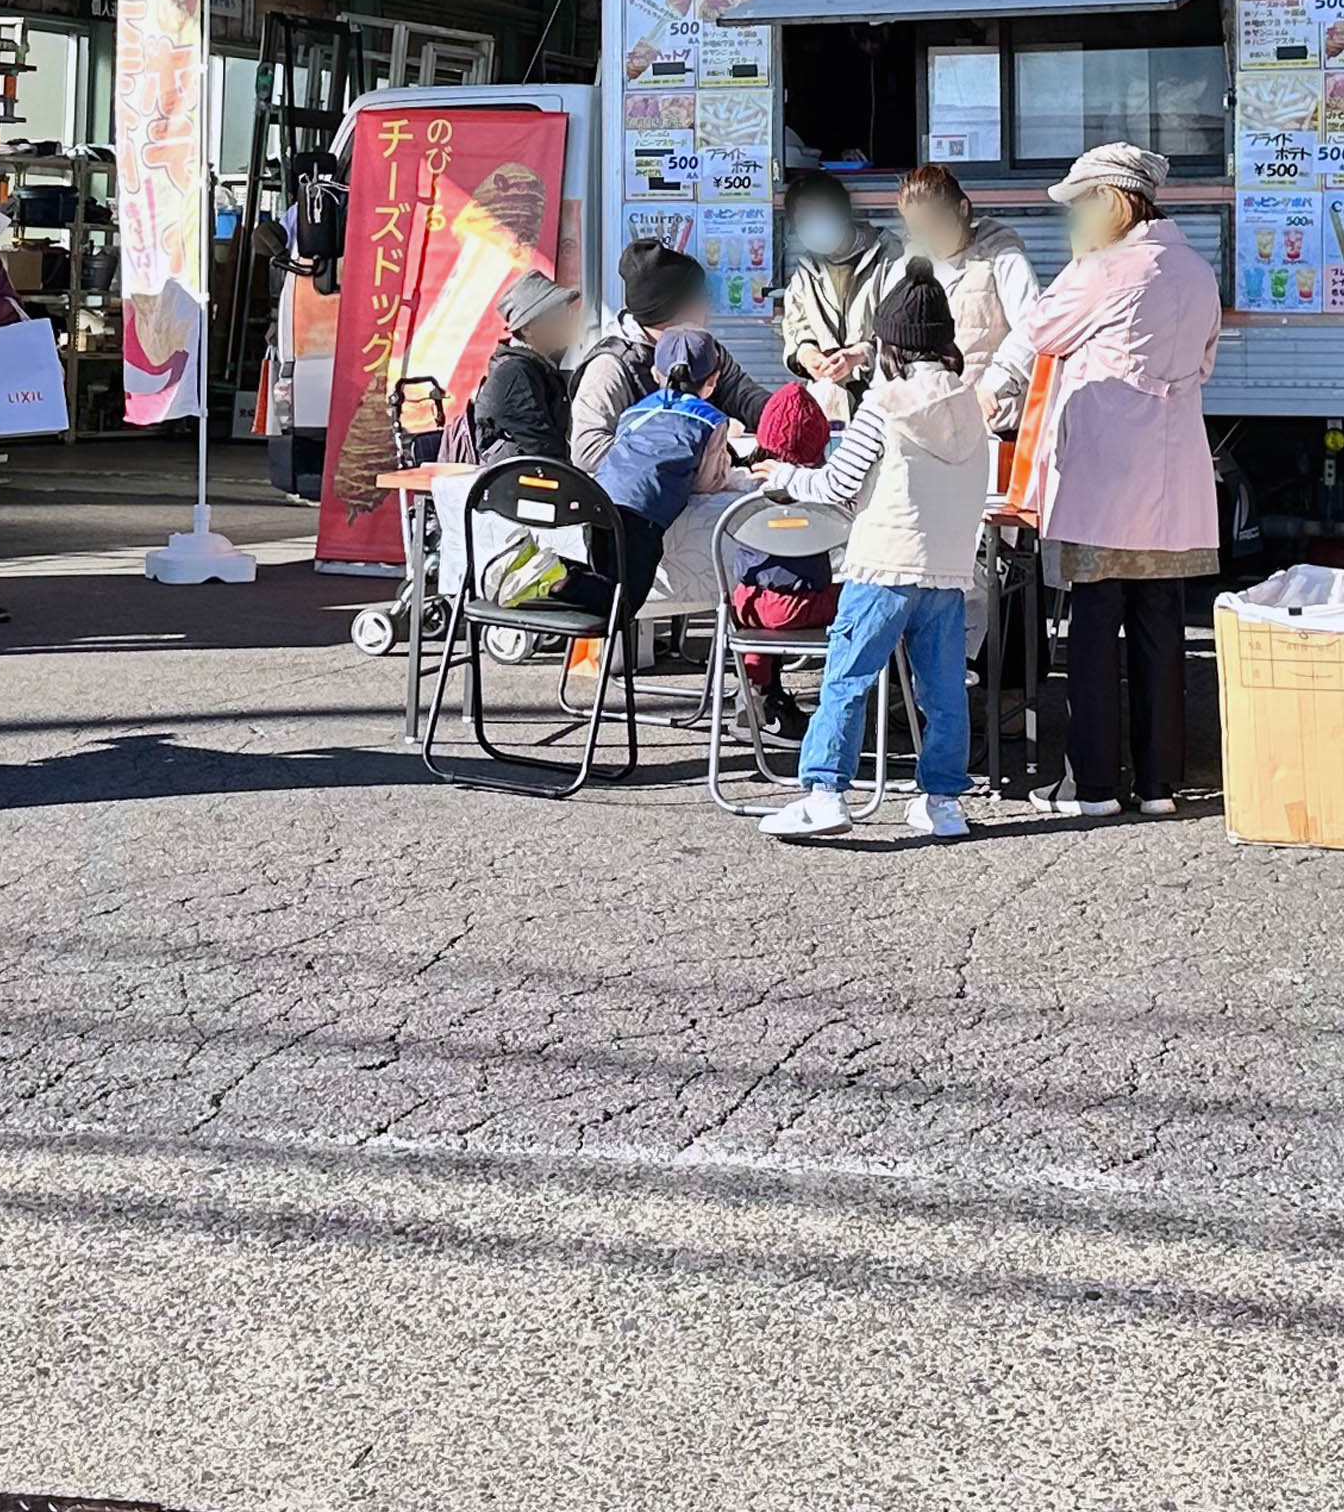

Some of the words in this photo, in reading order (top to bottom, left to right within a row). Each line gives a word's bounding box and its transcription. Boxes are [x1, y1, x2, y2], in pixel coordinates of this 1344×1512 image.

[670, 22, 700, 36] 500
[668, 156, 699, 170] 500
[1255, 163, 1298, 178] ¥500
[713, 176, 752, 190] ¥500
[629, 212, 694, 224] Churros
[7, 391, 44, 404] LIXIL
